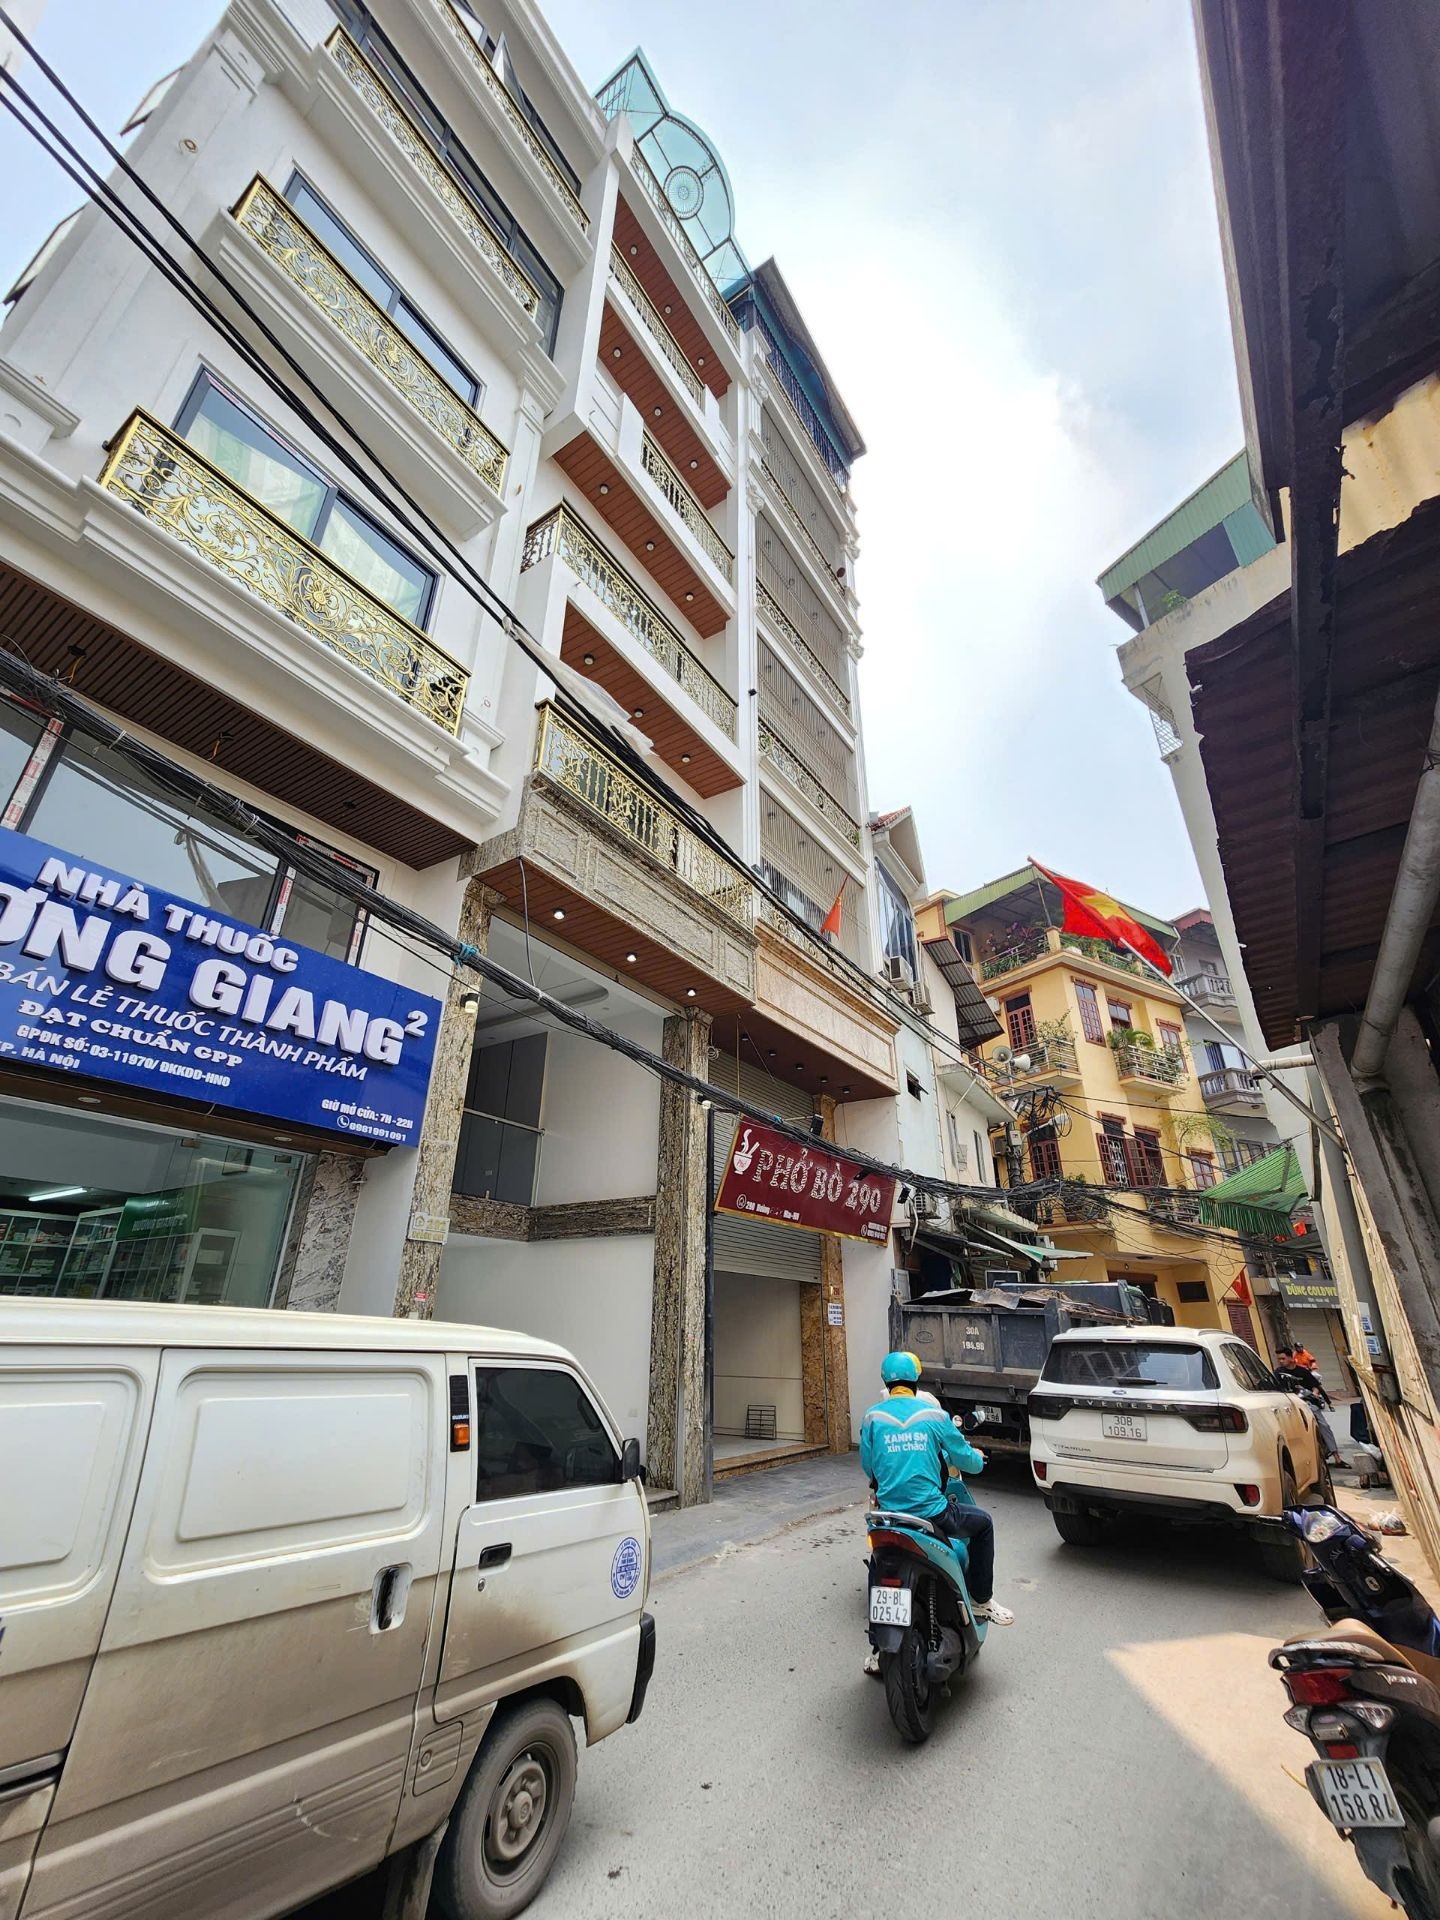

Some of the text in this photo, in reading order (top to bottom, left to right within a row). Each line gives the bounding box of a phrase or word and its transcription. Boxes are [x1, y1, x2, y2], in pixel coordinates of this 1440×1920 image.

[37, 857, 149, 920] NHÀ
[164, 903, 299, 972] THUỐC
[17, 1025, 63, 1046] GPĐK
[63, 1037, 91, 1053] SỐ:
[18, 1000, 243, 1067] ĐẠT CHUẨN GPP
[70, 985, 113, 1008] LẺ
[115, 996, 215, 1035] THUỐC
[218, 1026, 303, 1062] THÀNH
[303, 1051, 368, 1080] PHẨM
[21, 1046, 46, 1062] HÀ
[49, 1053, 81, 1070] NỘI
[321, 1099, 341, 1111] GIỜ
[340, 1102, 357, 1115] MỞ
[752, 1148, 881, 1216] PHỞ BÒ 290
[1073, 1399, 1169, 1411] EVEREST
[1114, 1415, 1133, 1426] 30B
[884, 1432, 928, 1444] XANH SM
[1108, 1426, 1142, 1438] 109.16
[887, 1443, 901, 1453] xin
[872, 1606, 908, 1624] 025.42
